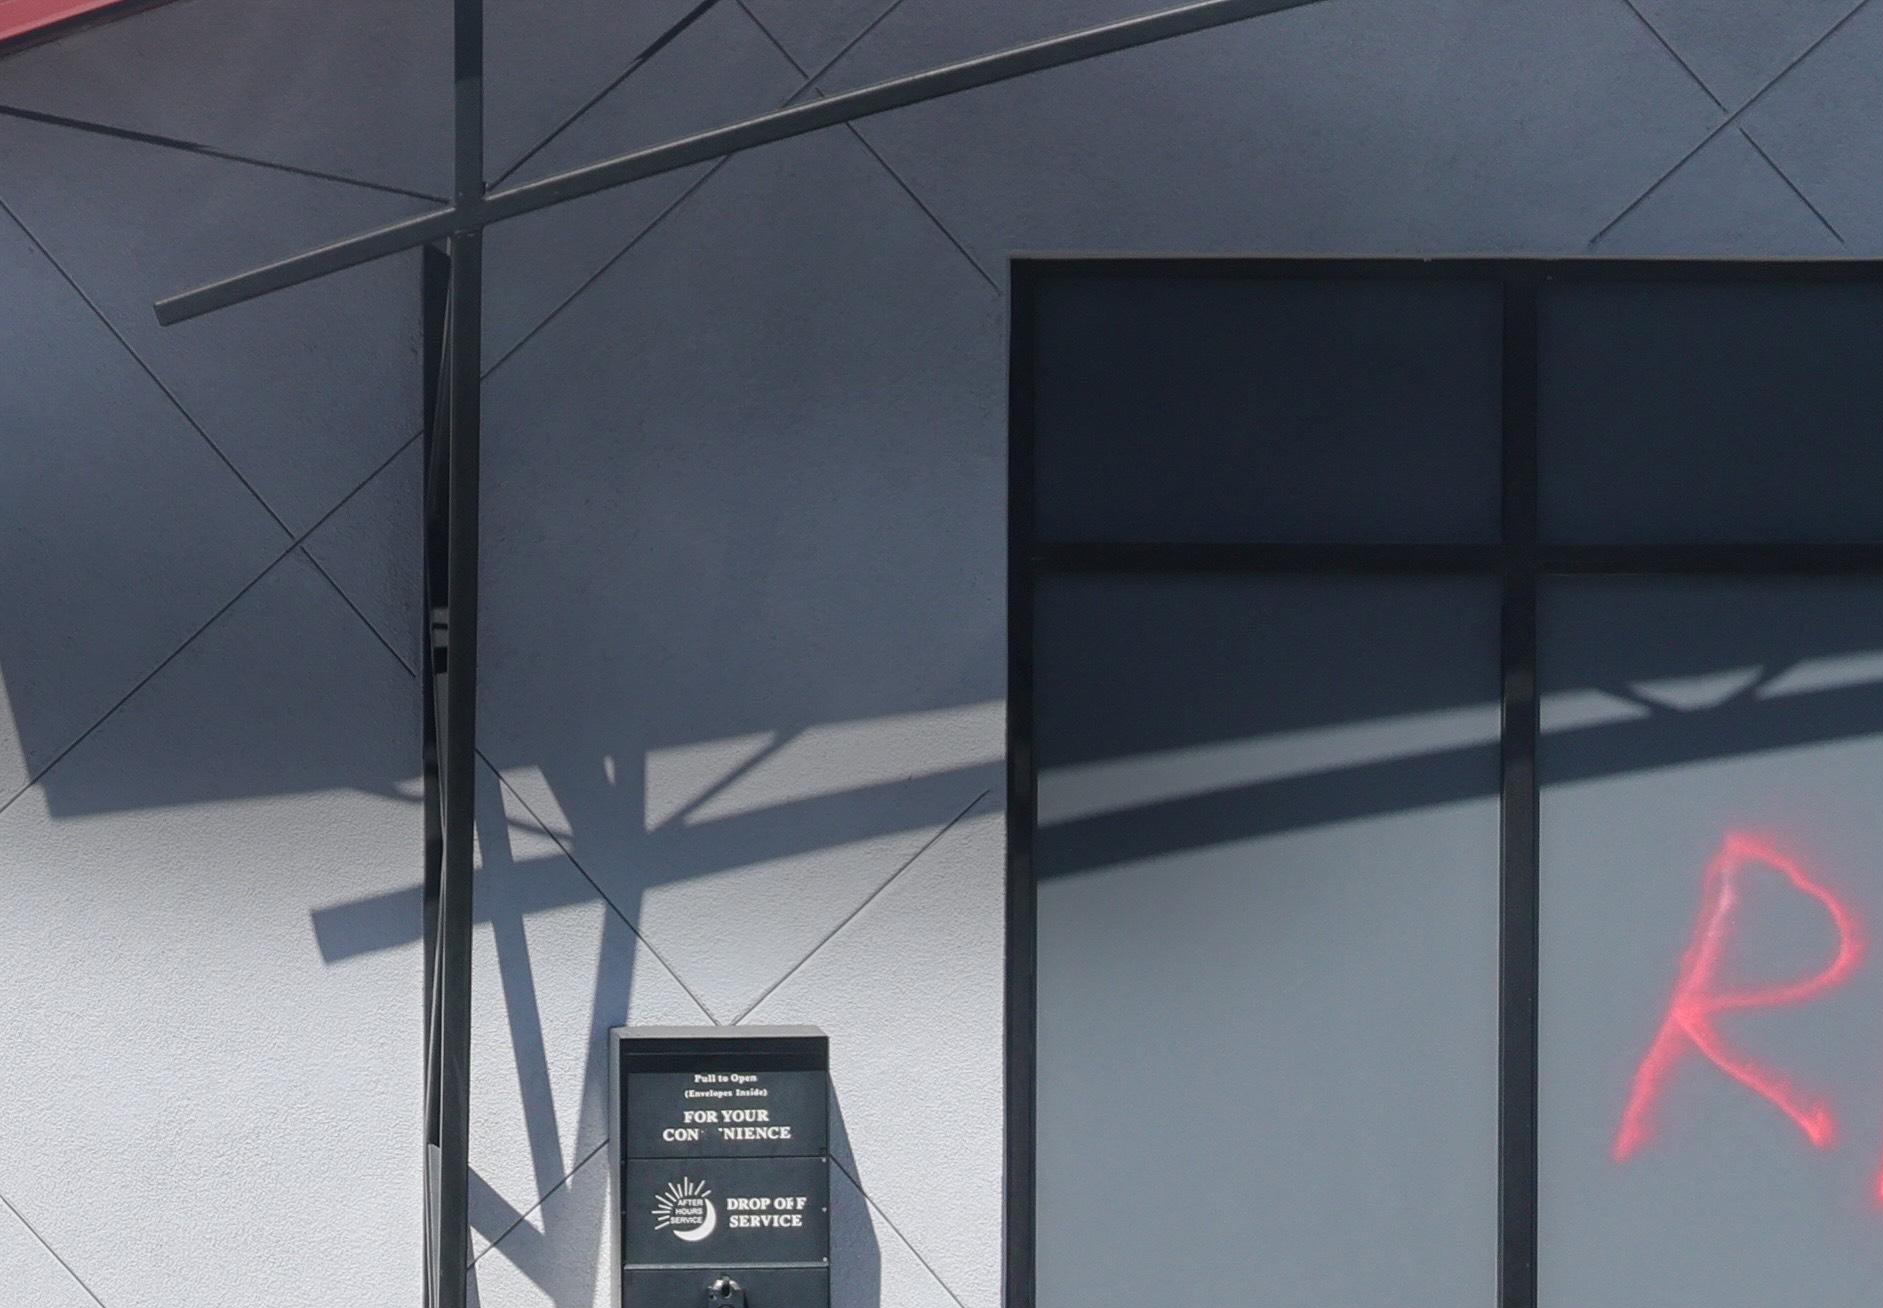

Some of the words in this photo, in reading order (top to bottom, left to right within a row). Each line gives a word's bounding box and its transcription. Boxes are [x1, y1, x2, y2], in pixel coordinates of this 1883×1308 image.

[694, 1074, 715, 1083] Pull
[717, 1074, 728, 1083] to
[730, 1074, 757, 1085] Open
[684, 1089, 732, 1099] (Envelopes
[735, 1088, 768, 1098] Inside)
[684, 1111, 717, 1123] FOR
[721, 1109, 769, 1122] YOUR
[663, 1126, 791, 1142] CONNIENCE
[727, 1198, 769, 1210] DROP
[675, 1207, 703, 1215] HOURS
[729, 1214, 803, 1228] SERVICE
